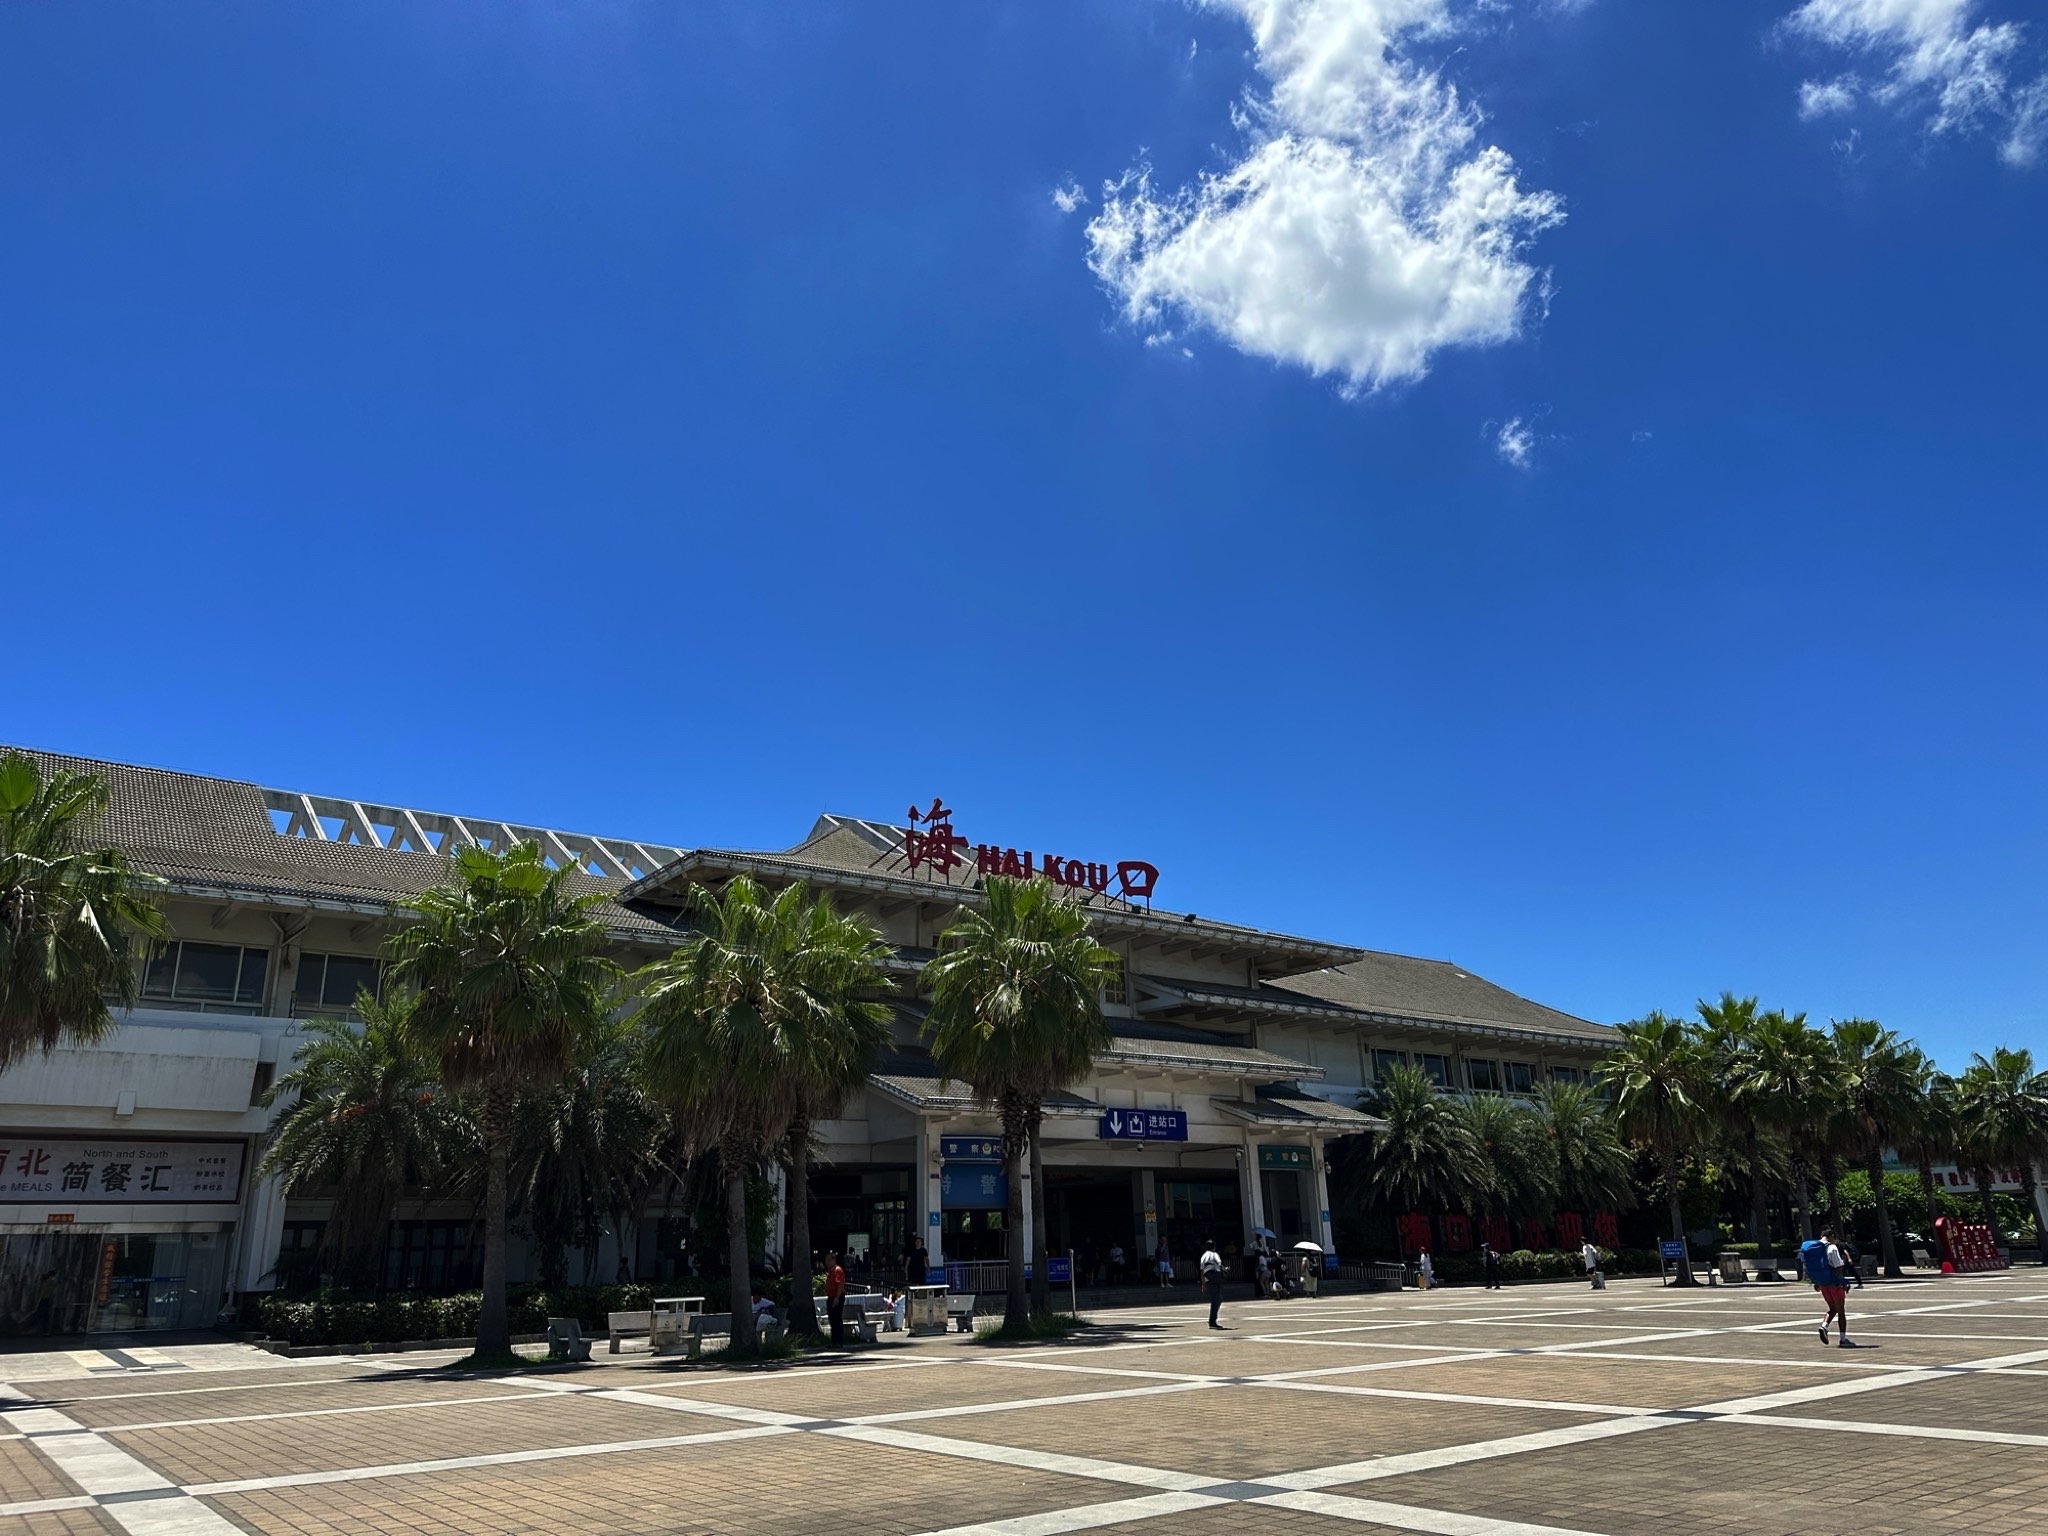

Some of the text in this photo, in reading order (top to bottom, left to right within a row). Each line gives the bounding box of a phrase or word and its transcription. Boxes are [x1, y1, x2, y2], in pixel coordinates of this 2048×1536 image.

[905, 797, 1160, 898] 海 HAI KOU 口
[1148, 1115, 1177, 1128] 进站口
[83, 1149, 169, 1159] North and South
[949, 1144, 979, 1154] 警察
[61, 1161, 173, 1193] 简餐汇
[10, 1182, 53, 1192] MEALS
